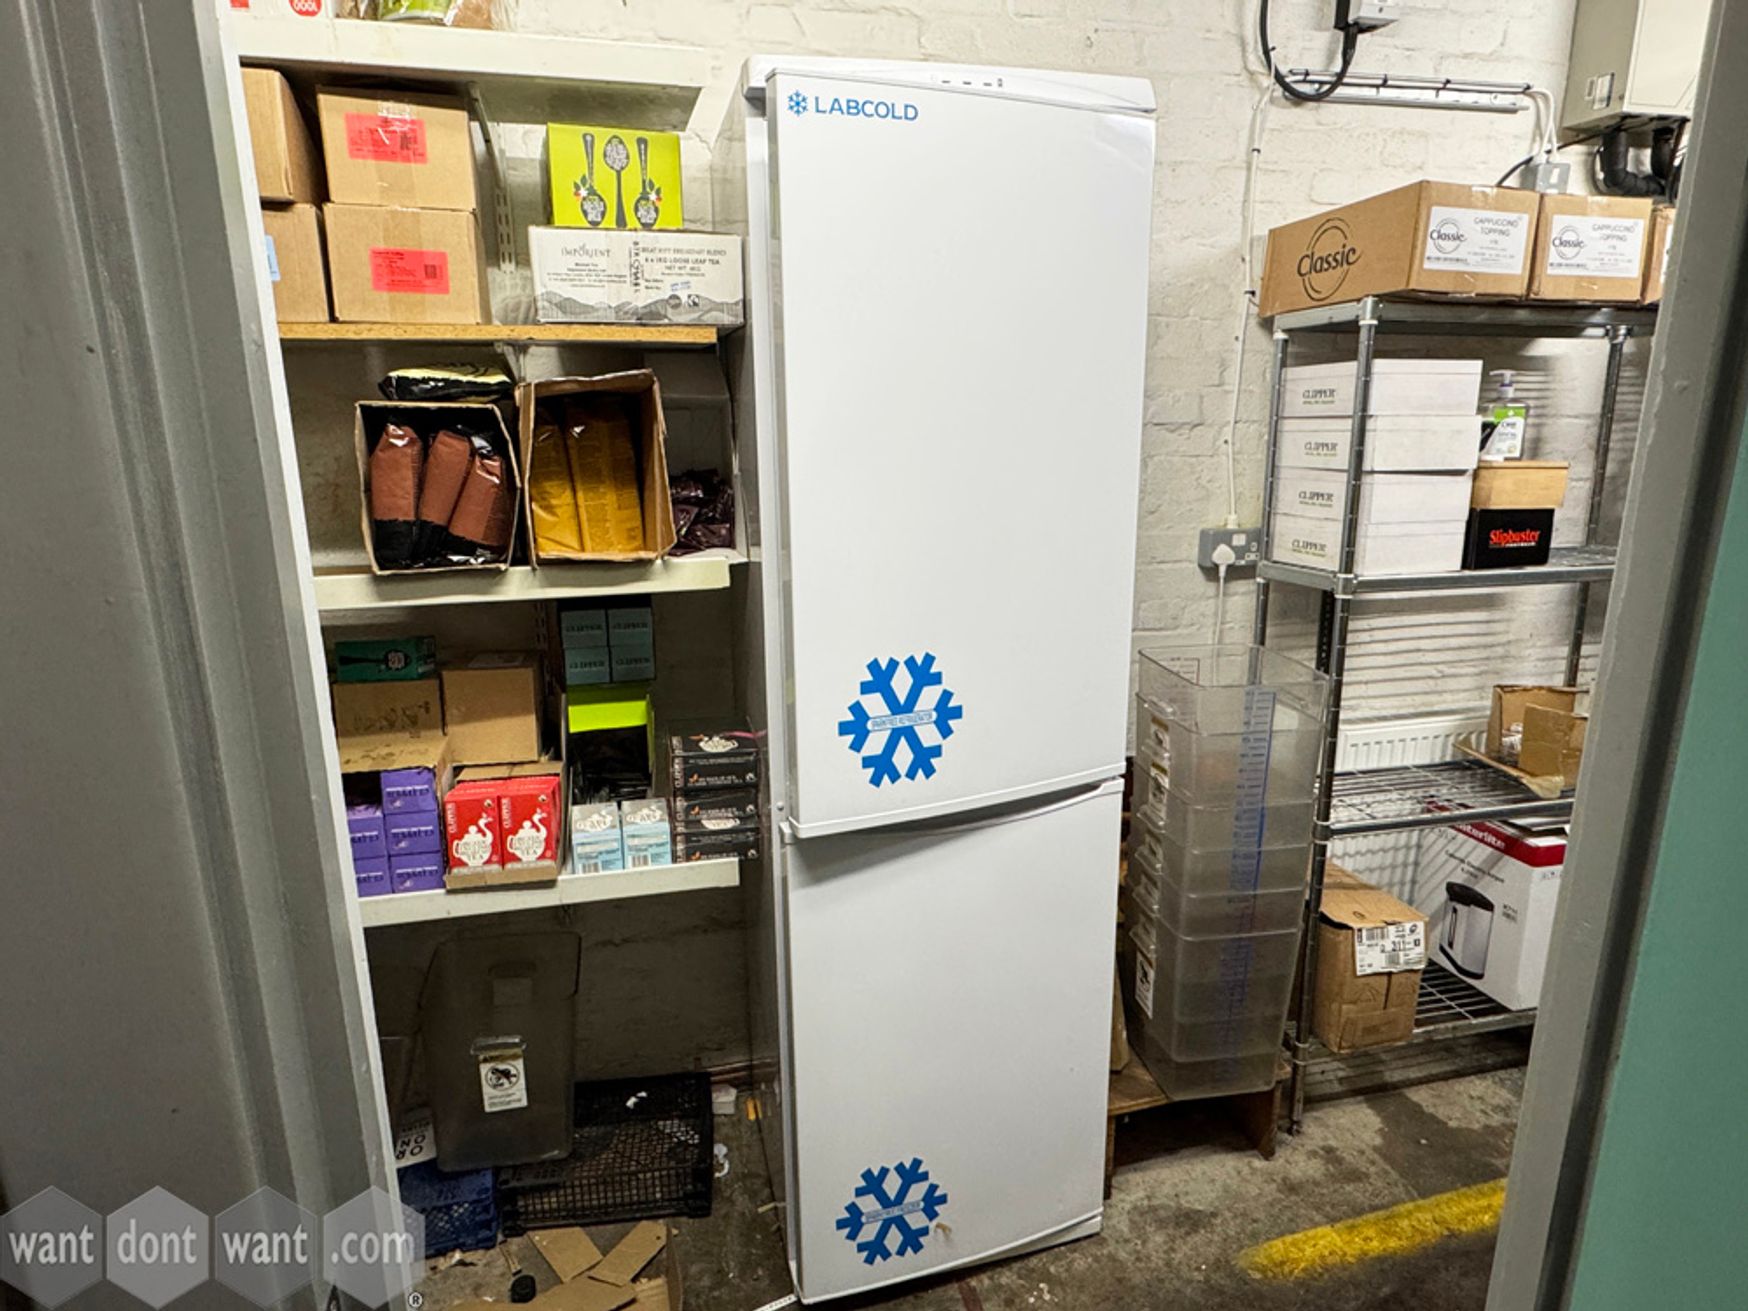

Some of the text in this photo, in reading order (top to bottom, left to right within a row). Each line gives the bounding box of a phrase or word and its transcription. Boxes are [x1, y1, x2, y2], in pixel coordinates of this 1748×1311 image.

[814, 96, 919, 121] LABCOLD
[1473, 217, 1518, 228] CAPPUCCINO
[1430, 229, 1467, 242] Classic
[1480, 227, 1510, 237] TOPPING
[1552, 236, 1586, 249] Classic
[1297, 243, 1362, 277] Classic
[1303, 388, 1336, 399] CLIPPER
[1304, 441, 1338, 452] CLIPPER
[1298, 490, 1334, 502] CLIPPER
[1489, 528, 1541, 546] Slipbuster
[1292, 539, 1327, 552] CLIPPER
